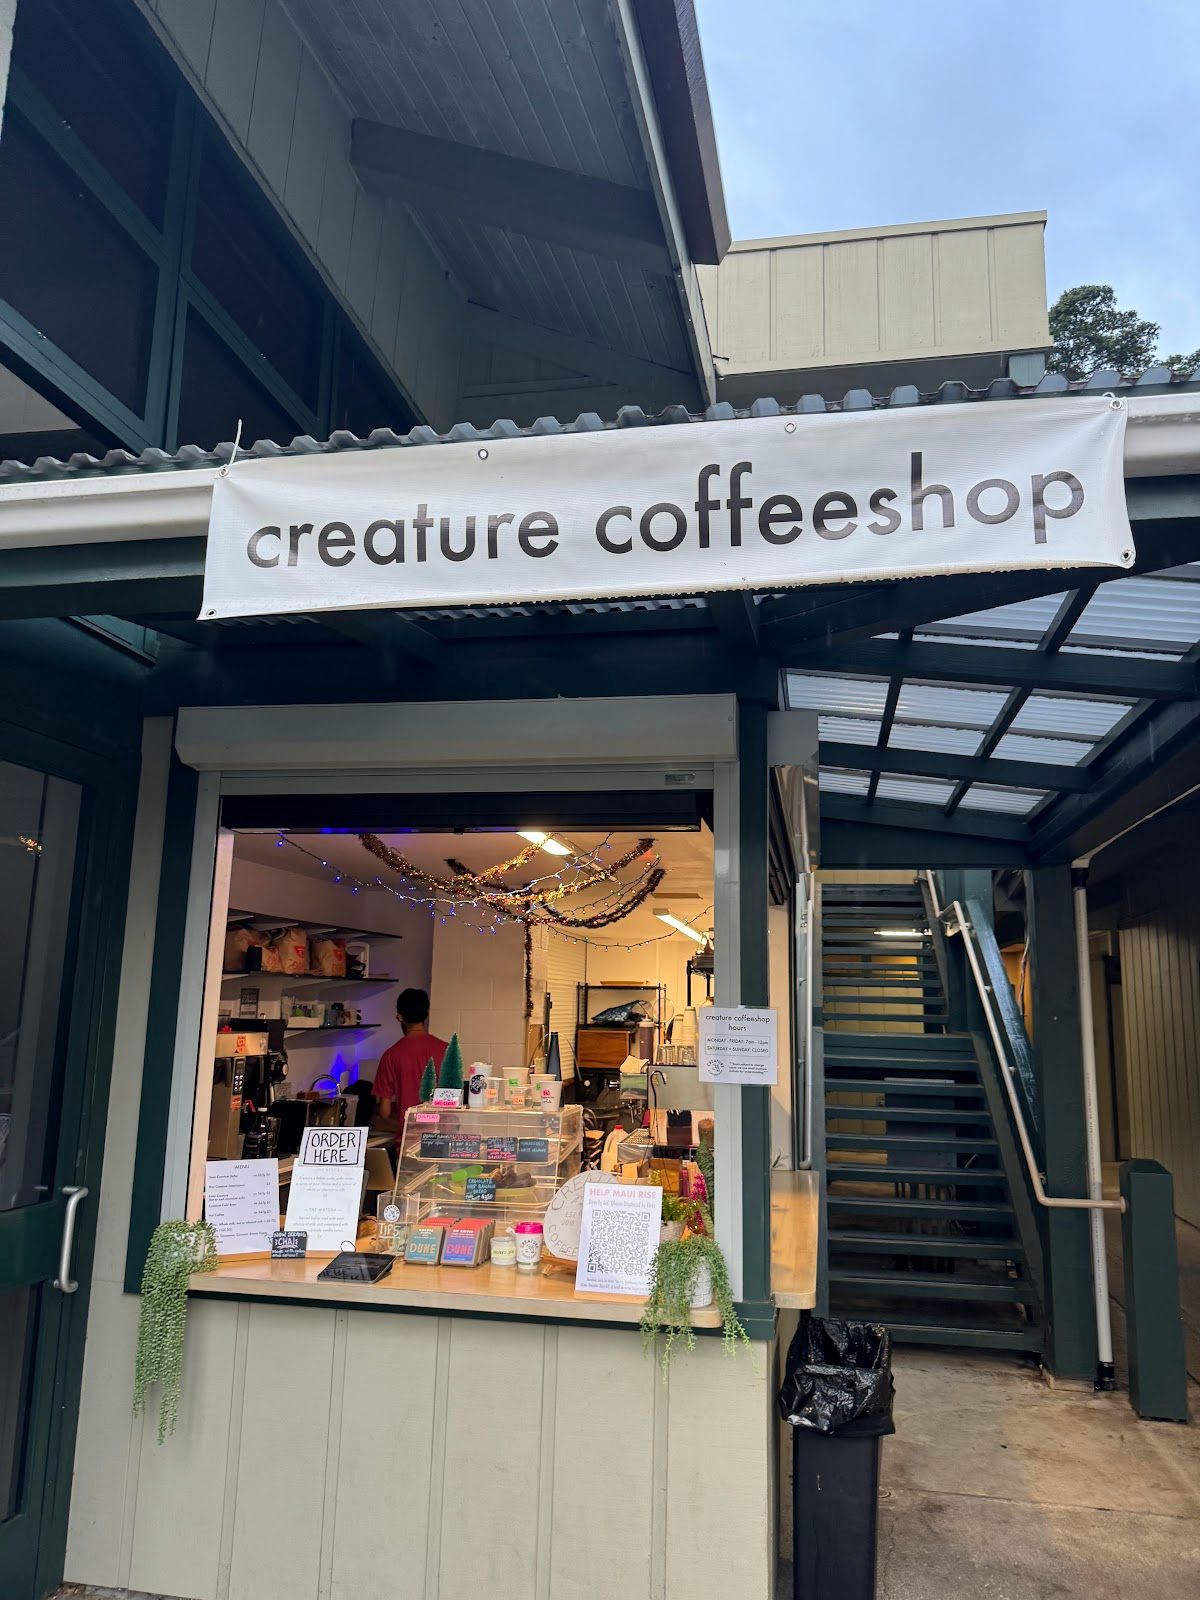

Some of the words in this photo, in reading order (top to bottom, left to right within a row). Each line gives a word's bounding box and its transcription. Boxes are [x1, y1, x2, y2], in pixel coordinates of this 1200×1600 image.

[247, 504, 559, 568] creature
[595, 452, 1085, 554] coffeeshop
[734, 1014, 770, 1024] coffeeshop
[311, 1132, 356, 1148] ORDER
[314, 1148, 348, 1163] HERE
[589, 1188, 609, 1196] HELP
[613, 1190, 636, 1198] MAUI
[379, 1223, 401, 1237] TIPS
[278, 1238, 296, 1246] CHAI
[409, 1243, 437, 1254] DUNE
[446, 1244, 473, 1256] DUNE
